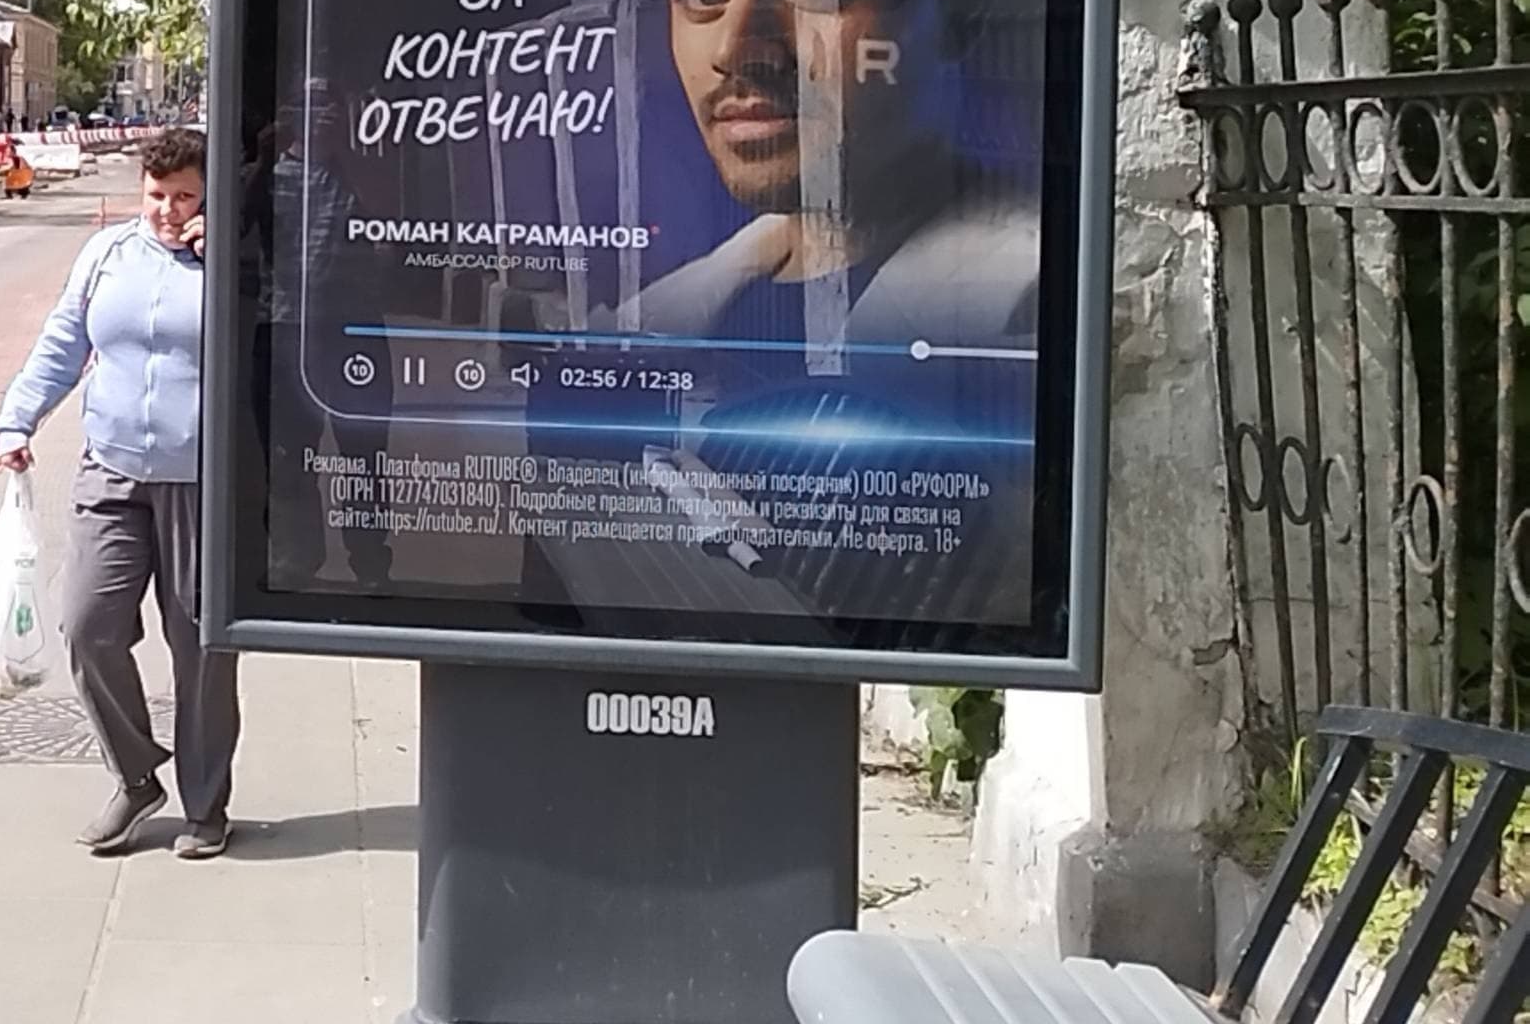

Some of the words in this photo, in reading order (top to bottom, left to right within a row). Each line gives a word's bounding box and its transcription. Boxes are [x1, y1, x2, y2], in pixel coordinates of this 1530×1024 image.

[384, 26, 616, 80] КОНТЕНТ
[357, 86, 616, 146] ОТВЕЧАЮ!
[348, 219, 449, 243] РОМАН
[404, 252, 521, 271] АМБАССАДОР
[525, 255, 590, 272] RUTUBE
[560, 368, 617, 388] 02:56
[638, 371, 694, 390] 12:38
[304, 447, 372, 475] Реклама.
[375, 450, 461, 483] Платформа
[547, 458, 621, 488] Владелец
[770, 468, 858, 499] посредник)
[862, 470, 897, 496] ООО
[899, 471, 991, 499] «РУФОРМ»
[330, 476, 374, 505] (ОГРН
[378, 477, 505, 511] 1127747031840).
[510, 483, 596, 516] Подробные
[599, 493, 663, 518] правила
[667, 488, 756, 523] платформы
[760, 502, 770, 517] и
[773, 500, 856, 525] реквизиты
[860, 505, 890, 525] для
[893, 506, 938, 525] связи
[941, 507, 961, 526] на
[508, 510, 568, 537] Контент
[571, 519, 673, 544] размещается
[677, 519, 838, 549] правообладателями.
[842, 526, 863, 550] Не
[866, 525, 930, 557] оферта.
[933, 528, 962, 554] 18+
[586, 692, 715, 736] 00039A
